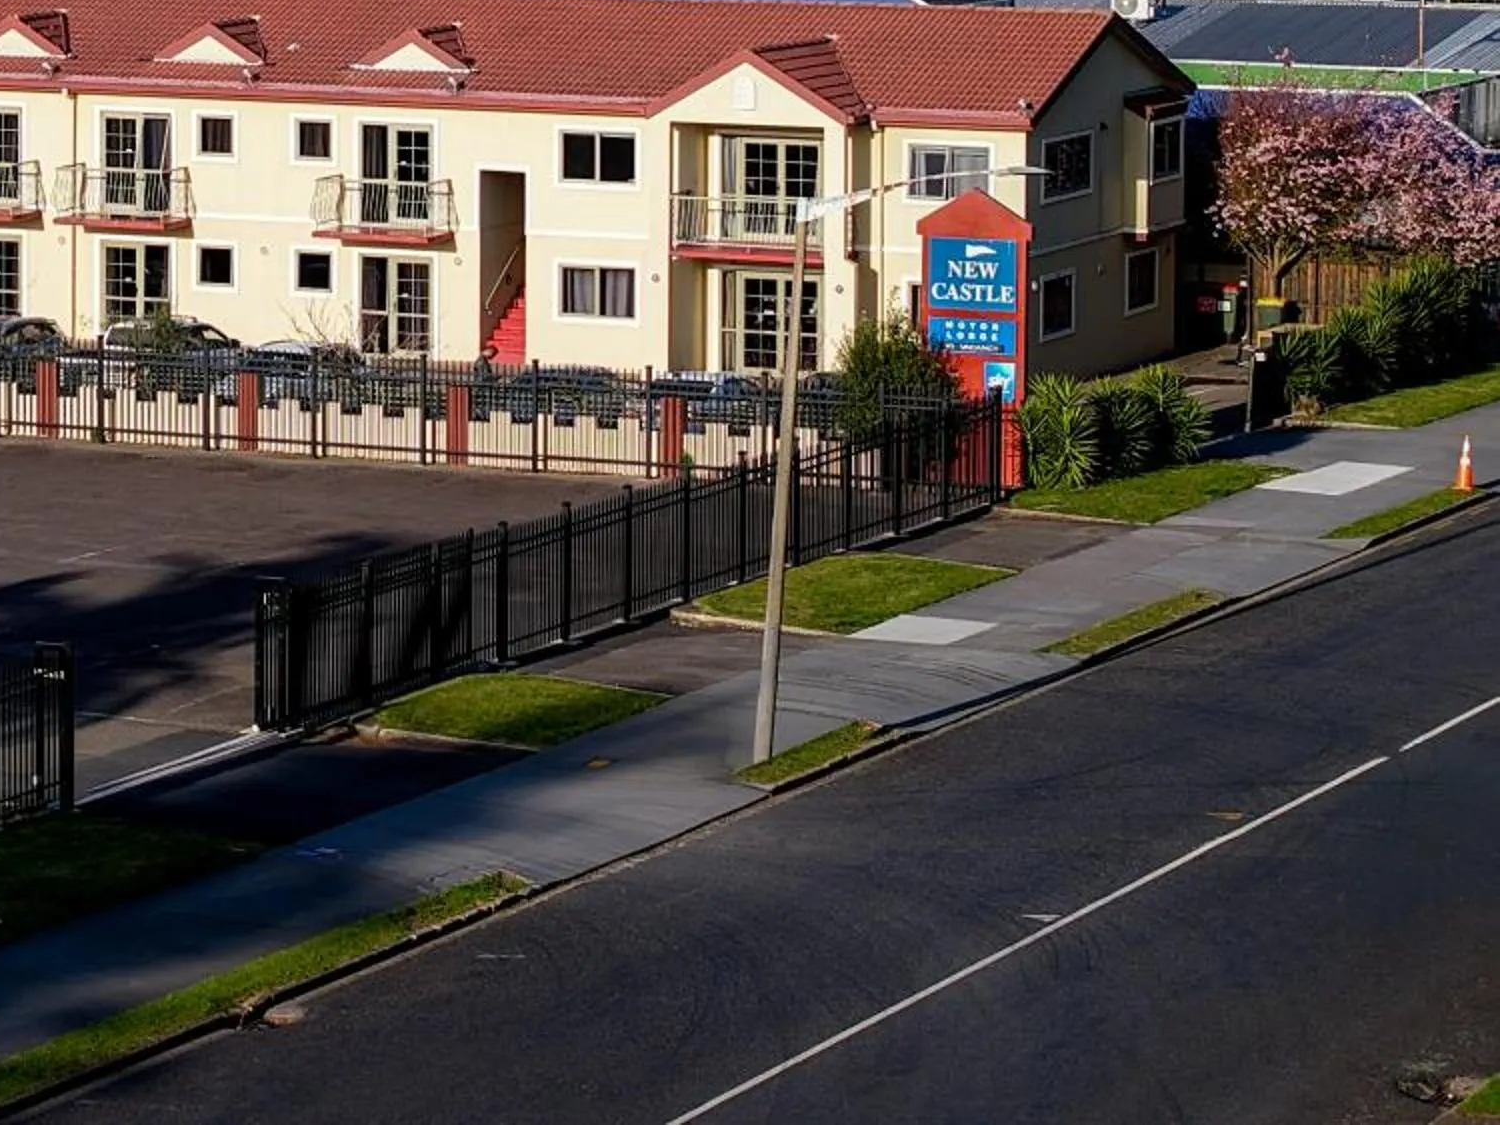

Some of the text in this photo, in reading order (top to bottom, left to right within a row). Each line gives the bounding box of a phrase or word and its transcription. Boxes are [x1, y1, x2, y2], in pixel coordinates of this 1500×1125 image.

[947, 260, 999, 279] NEW
[931, 282, 1015, 304] CASTLE
[944, 321, 999, 331] MOTOR
